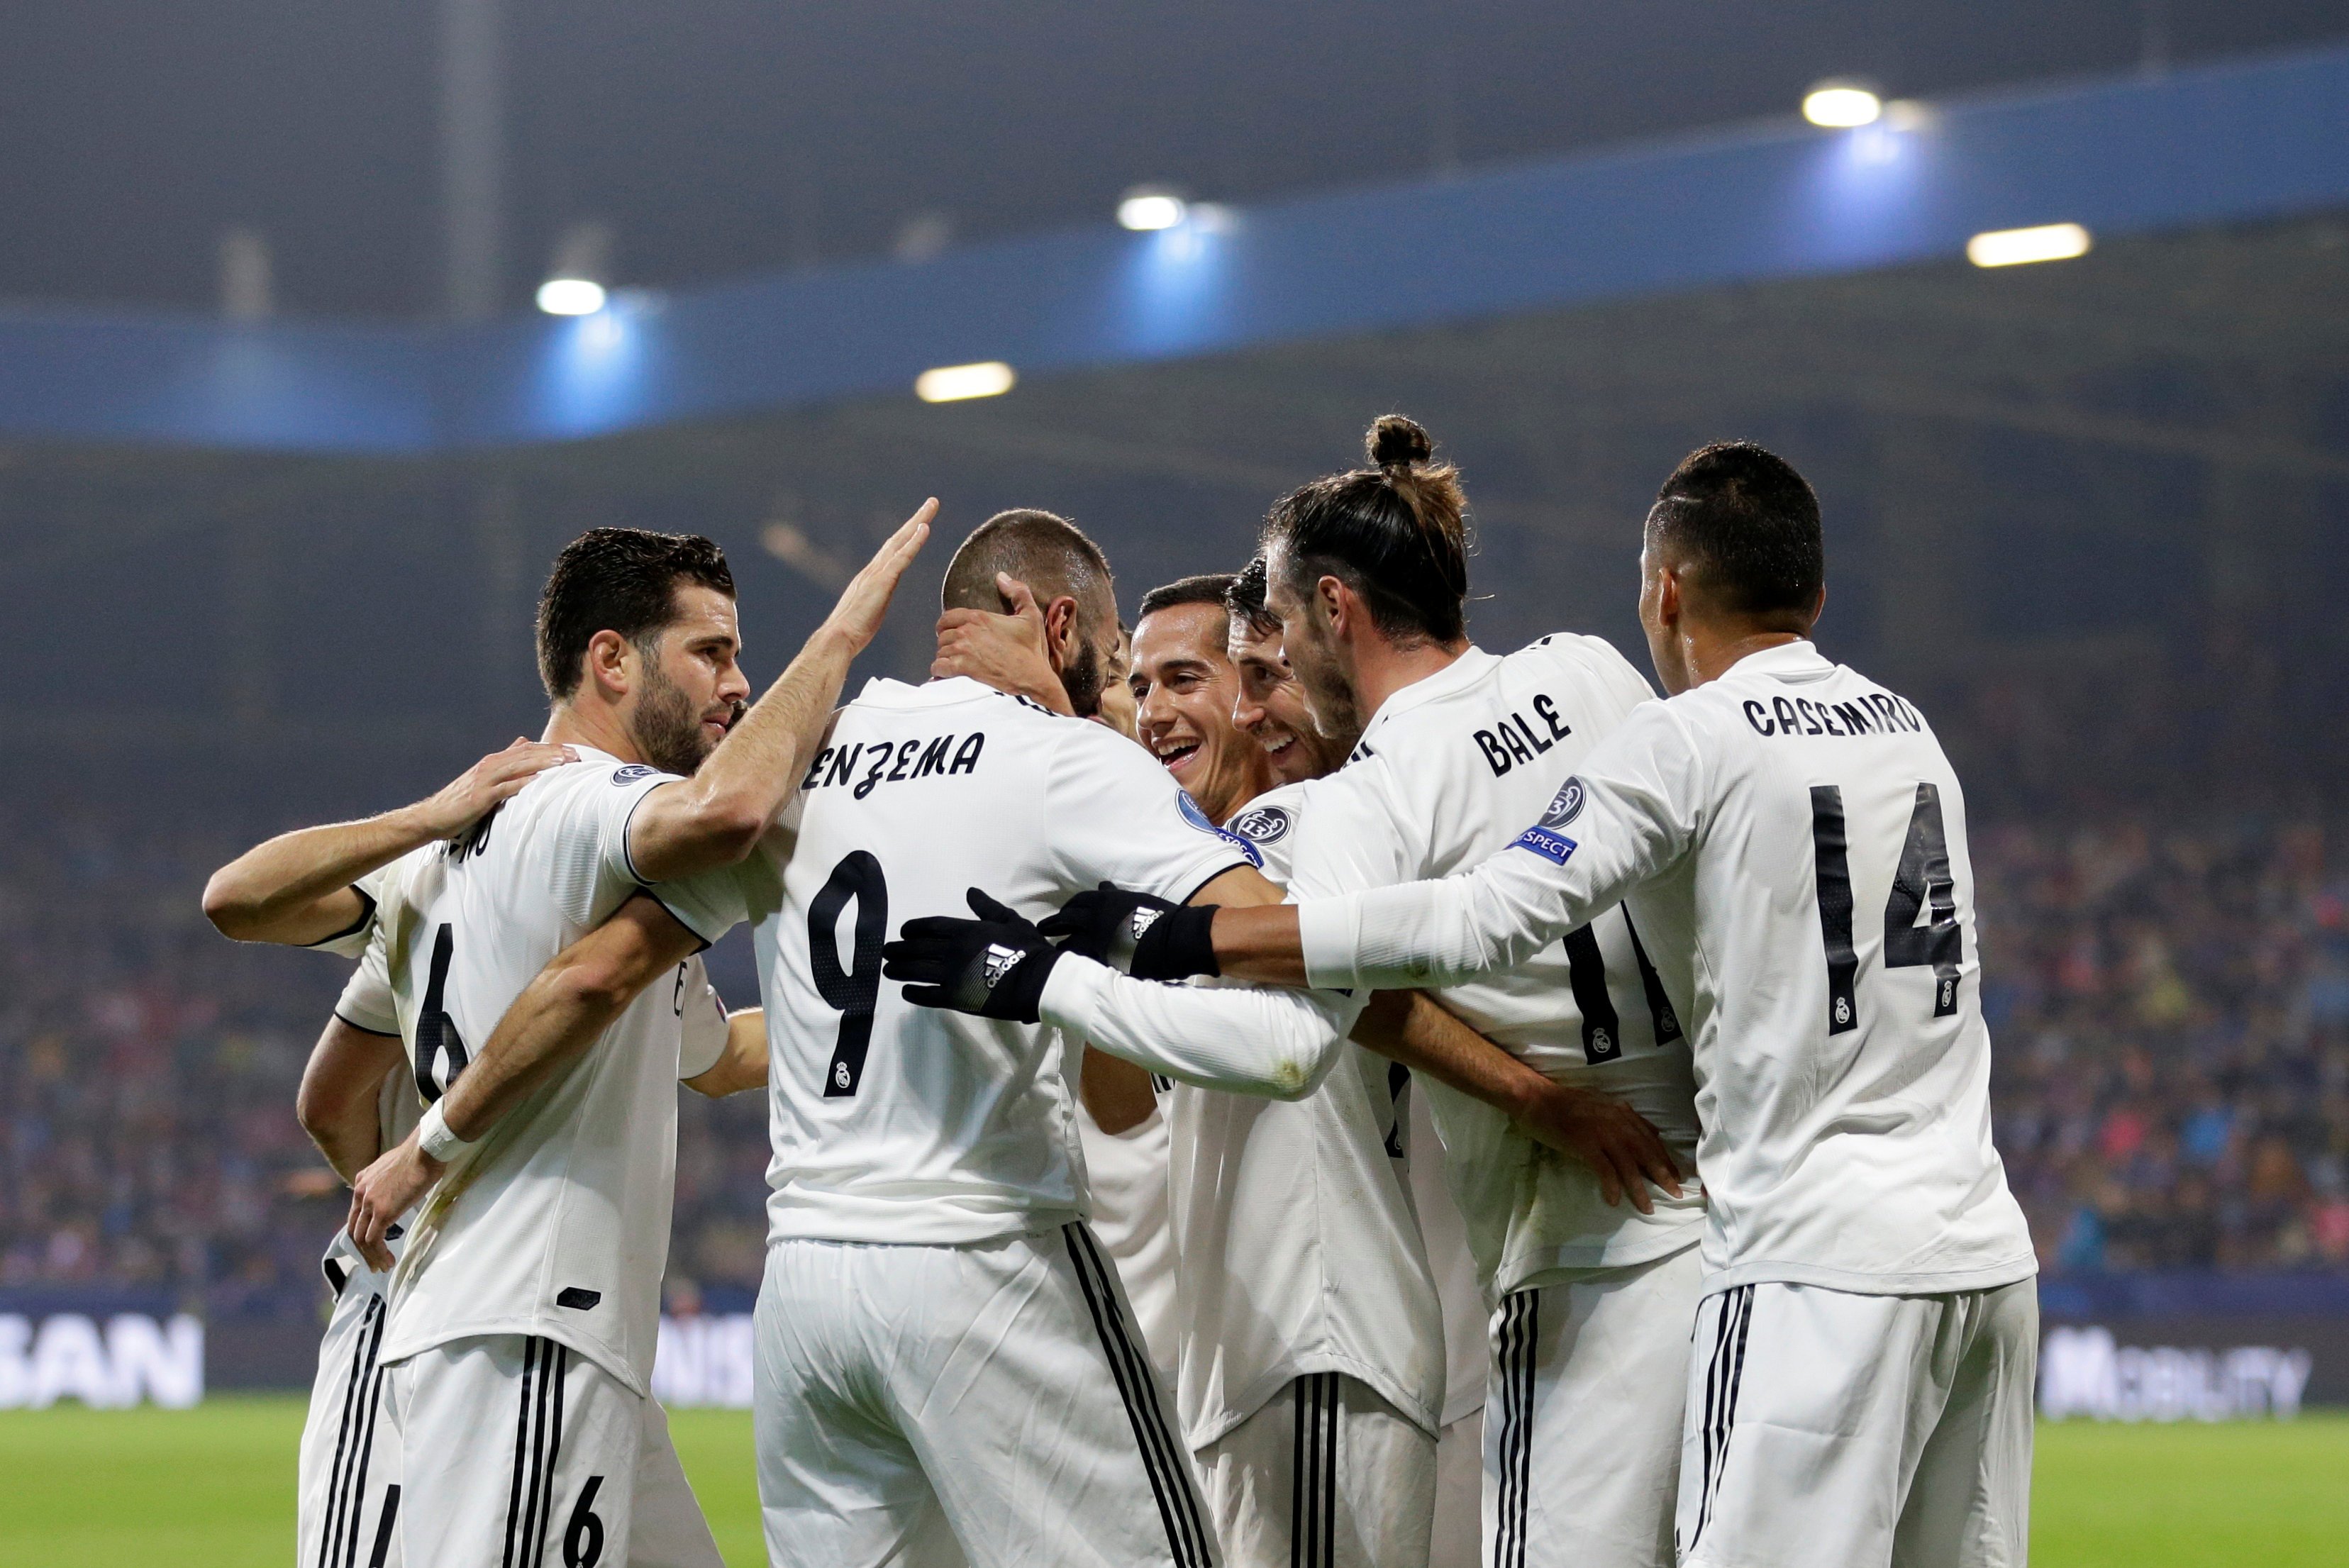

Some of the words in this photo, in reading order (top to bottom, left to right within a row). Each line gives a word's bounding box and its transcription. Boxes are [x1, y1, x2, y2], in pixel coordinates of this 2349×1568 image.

[1472, 694, 1572, 778] BALE
[1743, 694, 1921, 737] CASEMIRO
[801, 732, 985, 800] ENZEMA
[1242, 821, 1267, 838] 13
[1548, 800, 1564, 815] 3
[1516, 830, 1572, 857] SPECT
[1135, 910, 1165, 940] adidas
[1810, 782, 1964, 1036] 14
[807, 850, 889, 1097] 9
[987, 950, 1027, 989] adidas
[416, 923, 469, 1105] 6
[562, 1476, 605, 1568] 6
